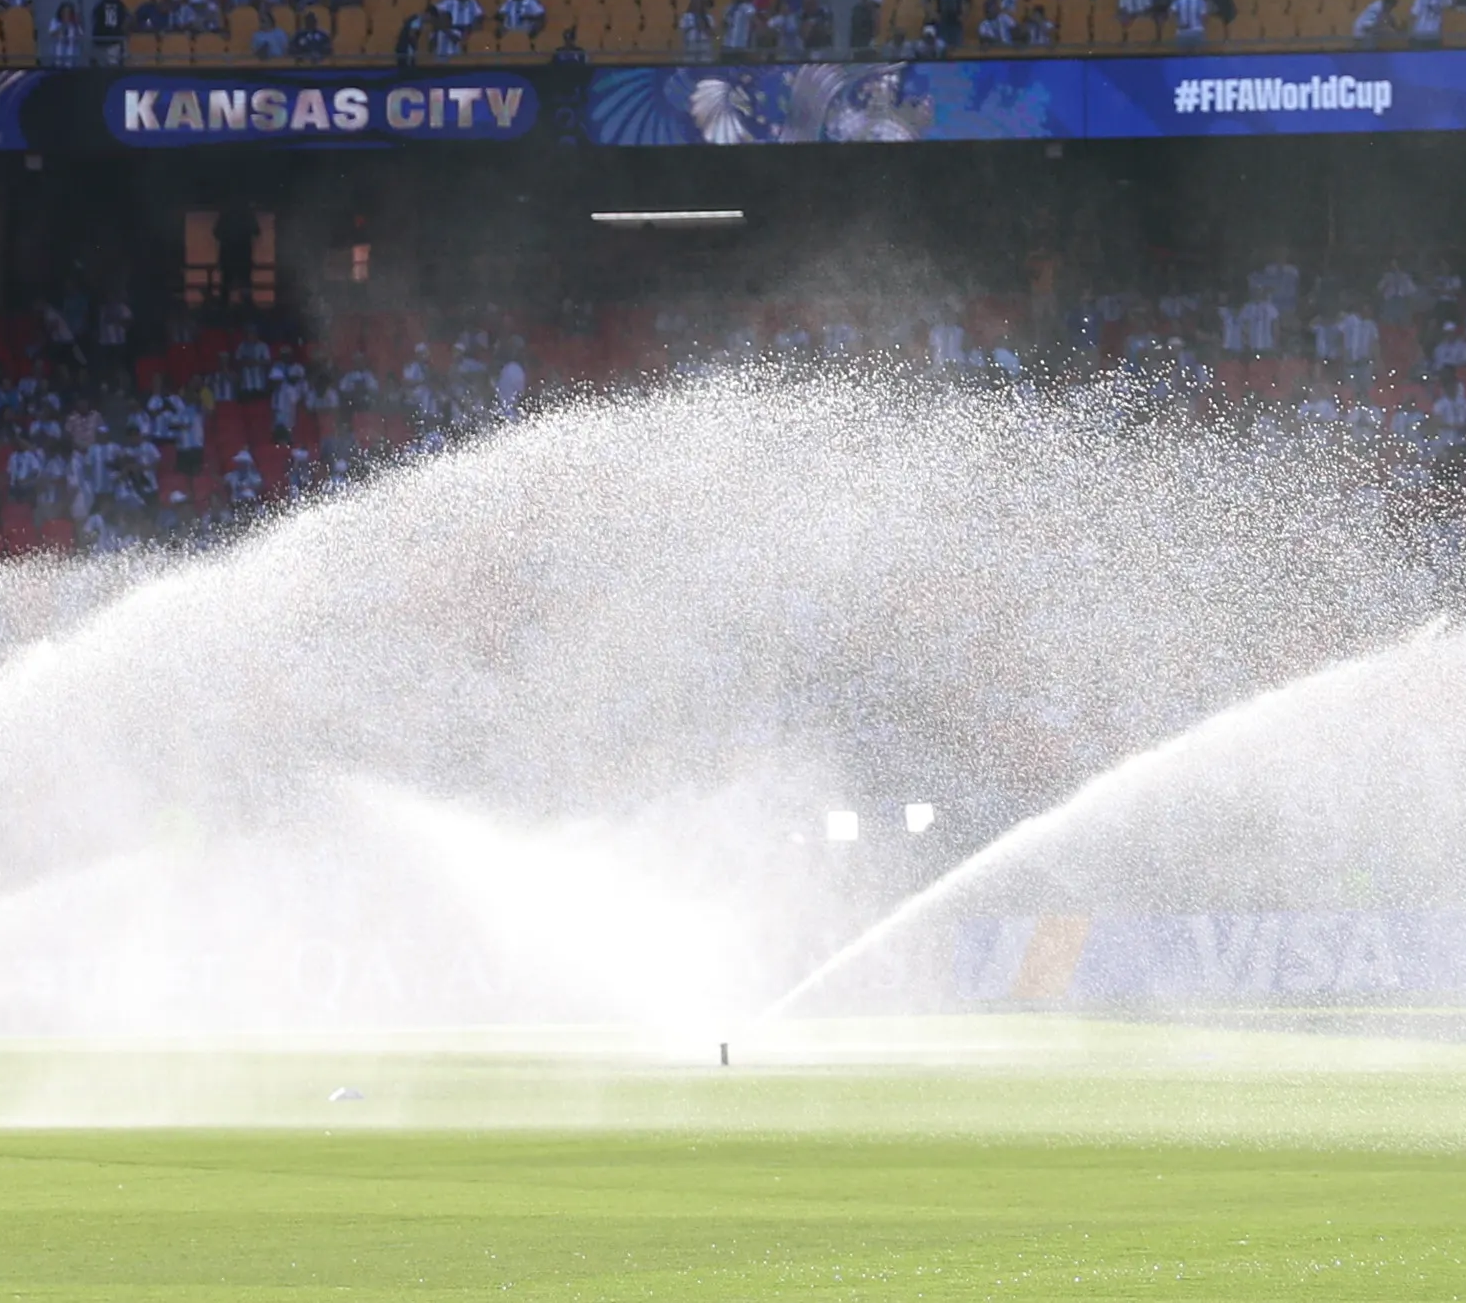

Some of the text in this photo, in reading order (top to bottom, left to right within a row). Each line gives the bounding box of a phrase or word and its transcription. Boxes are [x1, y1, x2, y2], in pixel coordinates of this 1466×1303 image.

[124, 86, 524, 132] KANSAS CITY
[1174, 75, 1392, 115] #FIFAWorldCup
